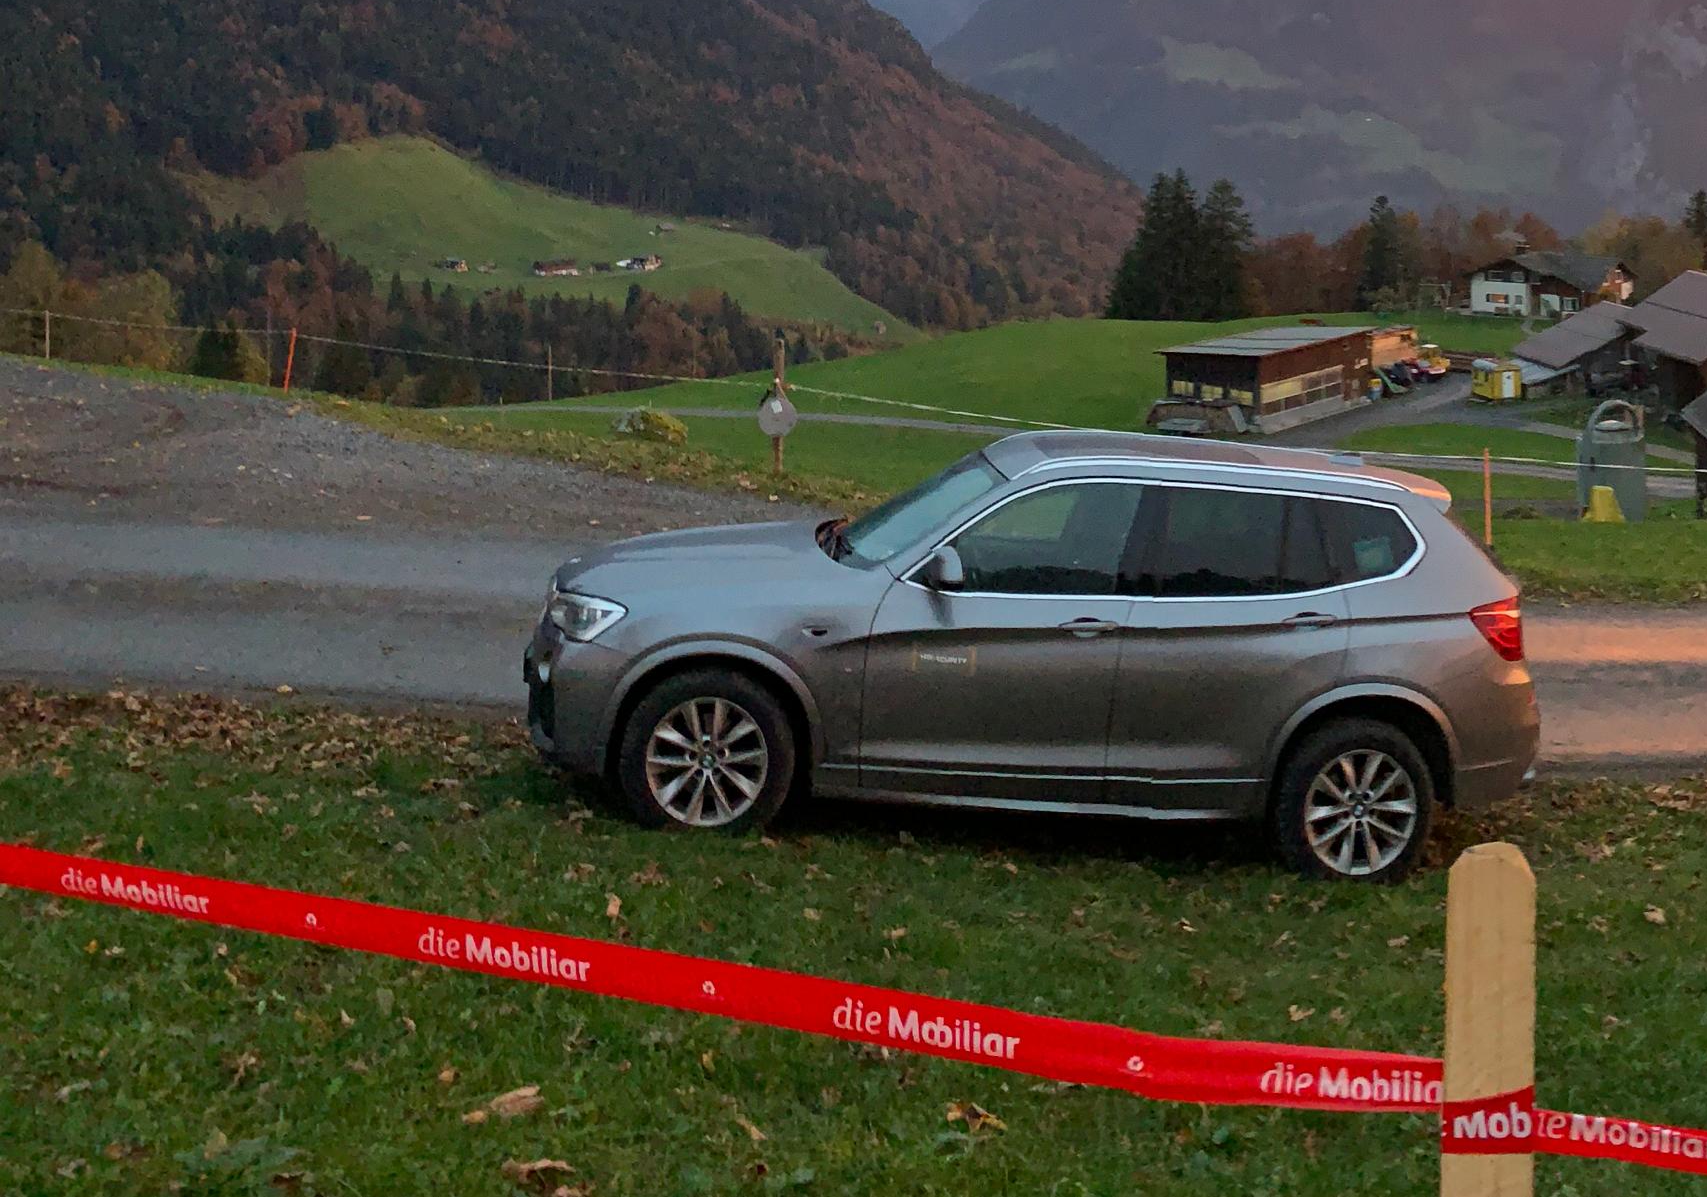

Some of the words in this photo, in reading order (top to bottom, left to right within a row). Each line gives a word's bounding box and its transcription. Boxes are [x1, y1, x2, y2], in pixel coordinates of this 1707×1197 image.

[61, 867, 98, 896] die
[101, 874, 209, 915] Mobiliar
[418, 927, 461, 961] die
[465, 933, 591, 983] Mobiliar
[832, 998, 882, 1035] die
[888, 1006, 1021, 1060] Mobiliar
[1260, 1062, 1314, 1096] die
[1318, 1066, 1445, 1104] Mobilia
